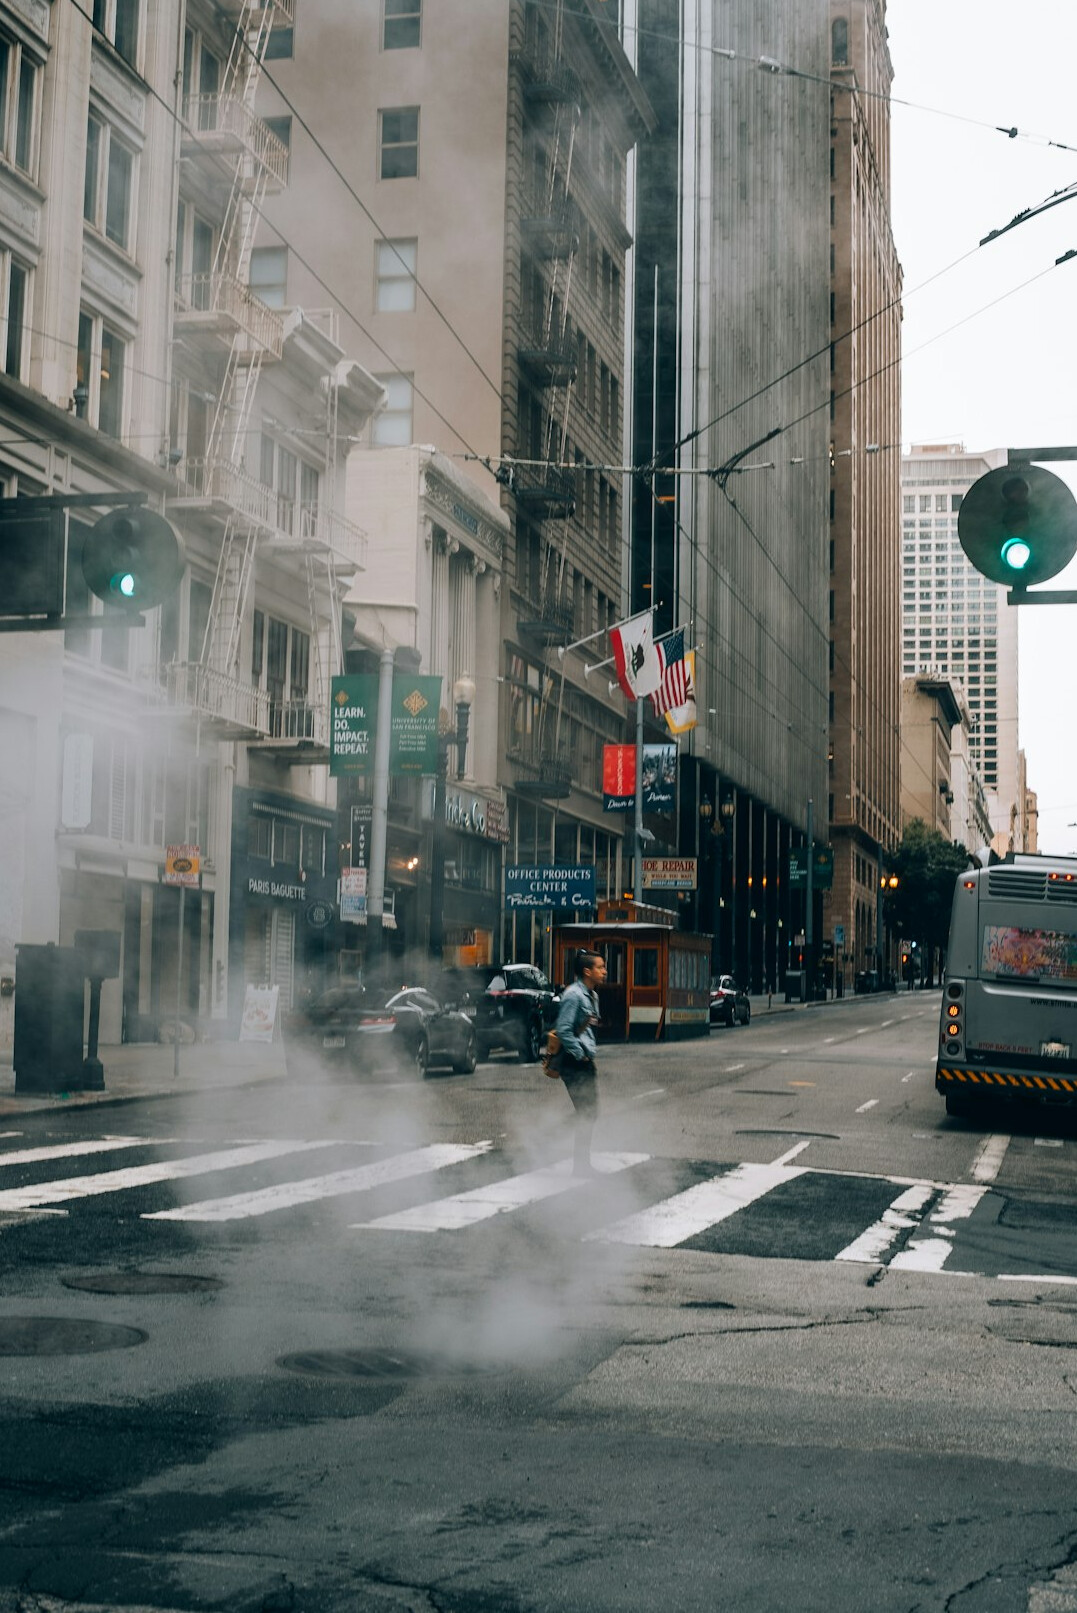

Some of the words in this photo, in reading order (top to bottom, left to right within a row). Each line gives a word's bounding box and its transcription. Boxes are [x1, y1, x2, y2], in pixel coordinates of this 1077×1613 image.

[334, 707, 366, 718] LEARN.
[334, 719, 350, 730] DO.
[334, 731, 369, 742] IMPACT.
[334, 742, 368, 755] REPEAT.
[358, 825, 366, 867] TAVER
[662, 860, 694, 871] REPAIR
[508, 869, 540, 880] OFFICE
[543, 869, 591, 880] PRODUCTS
[248, 878, 270, 895] PARIS
[270, 882, 306, 900] BAGUETTE
[530, 881, 568, 892] CENTER
